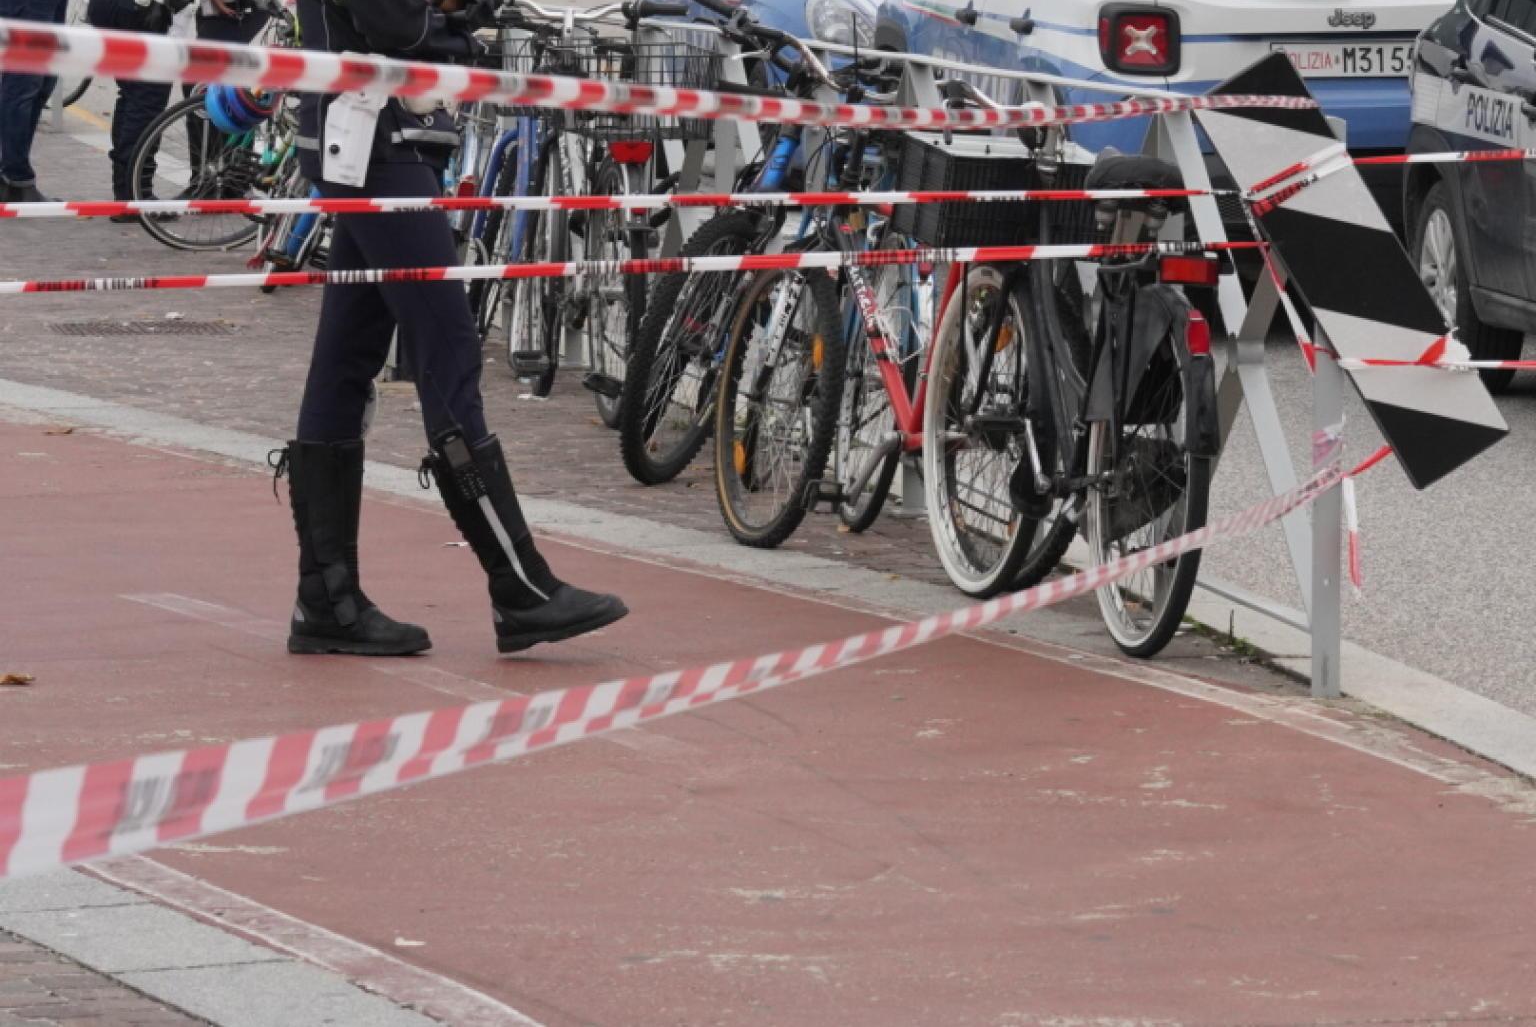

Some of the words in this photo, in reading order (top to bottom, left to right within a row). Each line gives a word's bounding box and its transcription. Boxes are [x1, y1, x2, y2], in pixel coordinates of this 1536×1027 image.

[1327, 8, 1377, 30] Jeep
[1285, 50, 1333, 71] OLIZIA
[1465, 92, 1515, 141] POLIZIA
